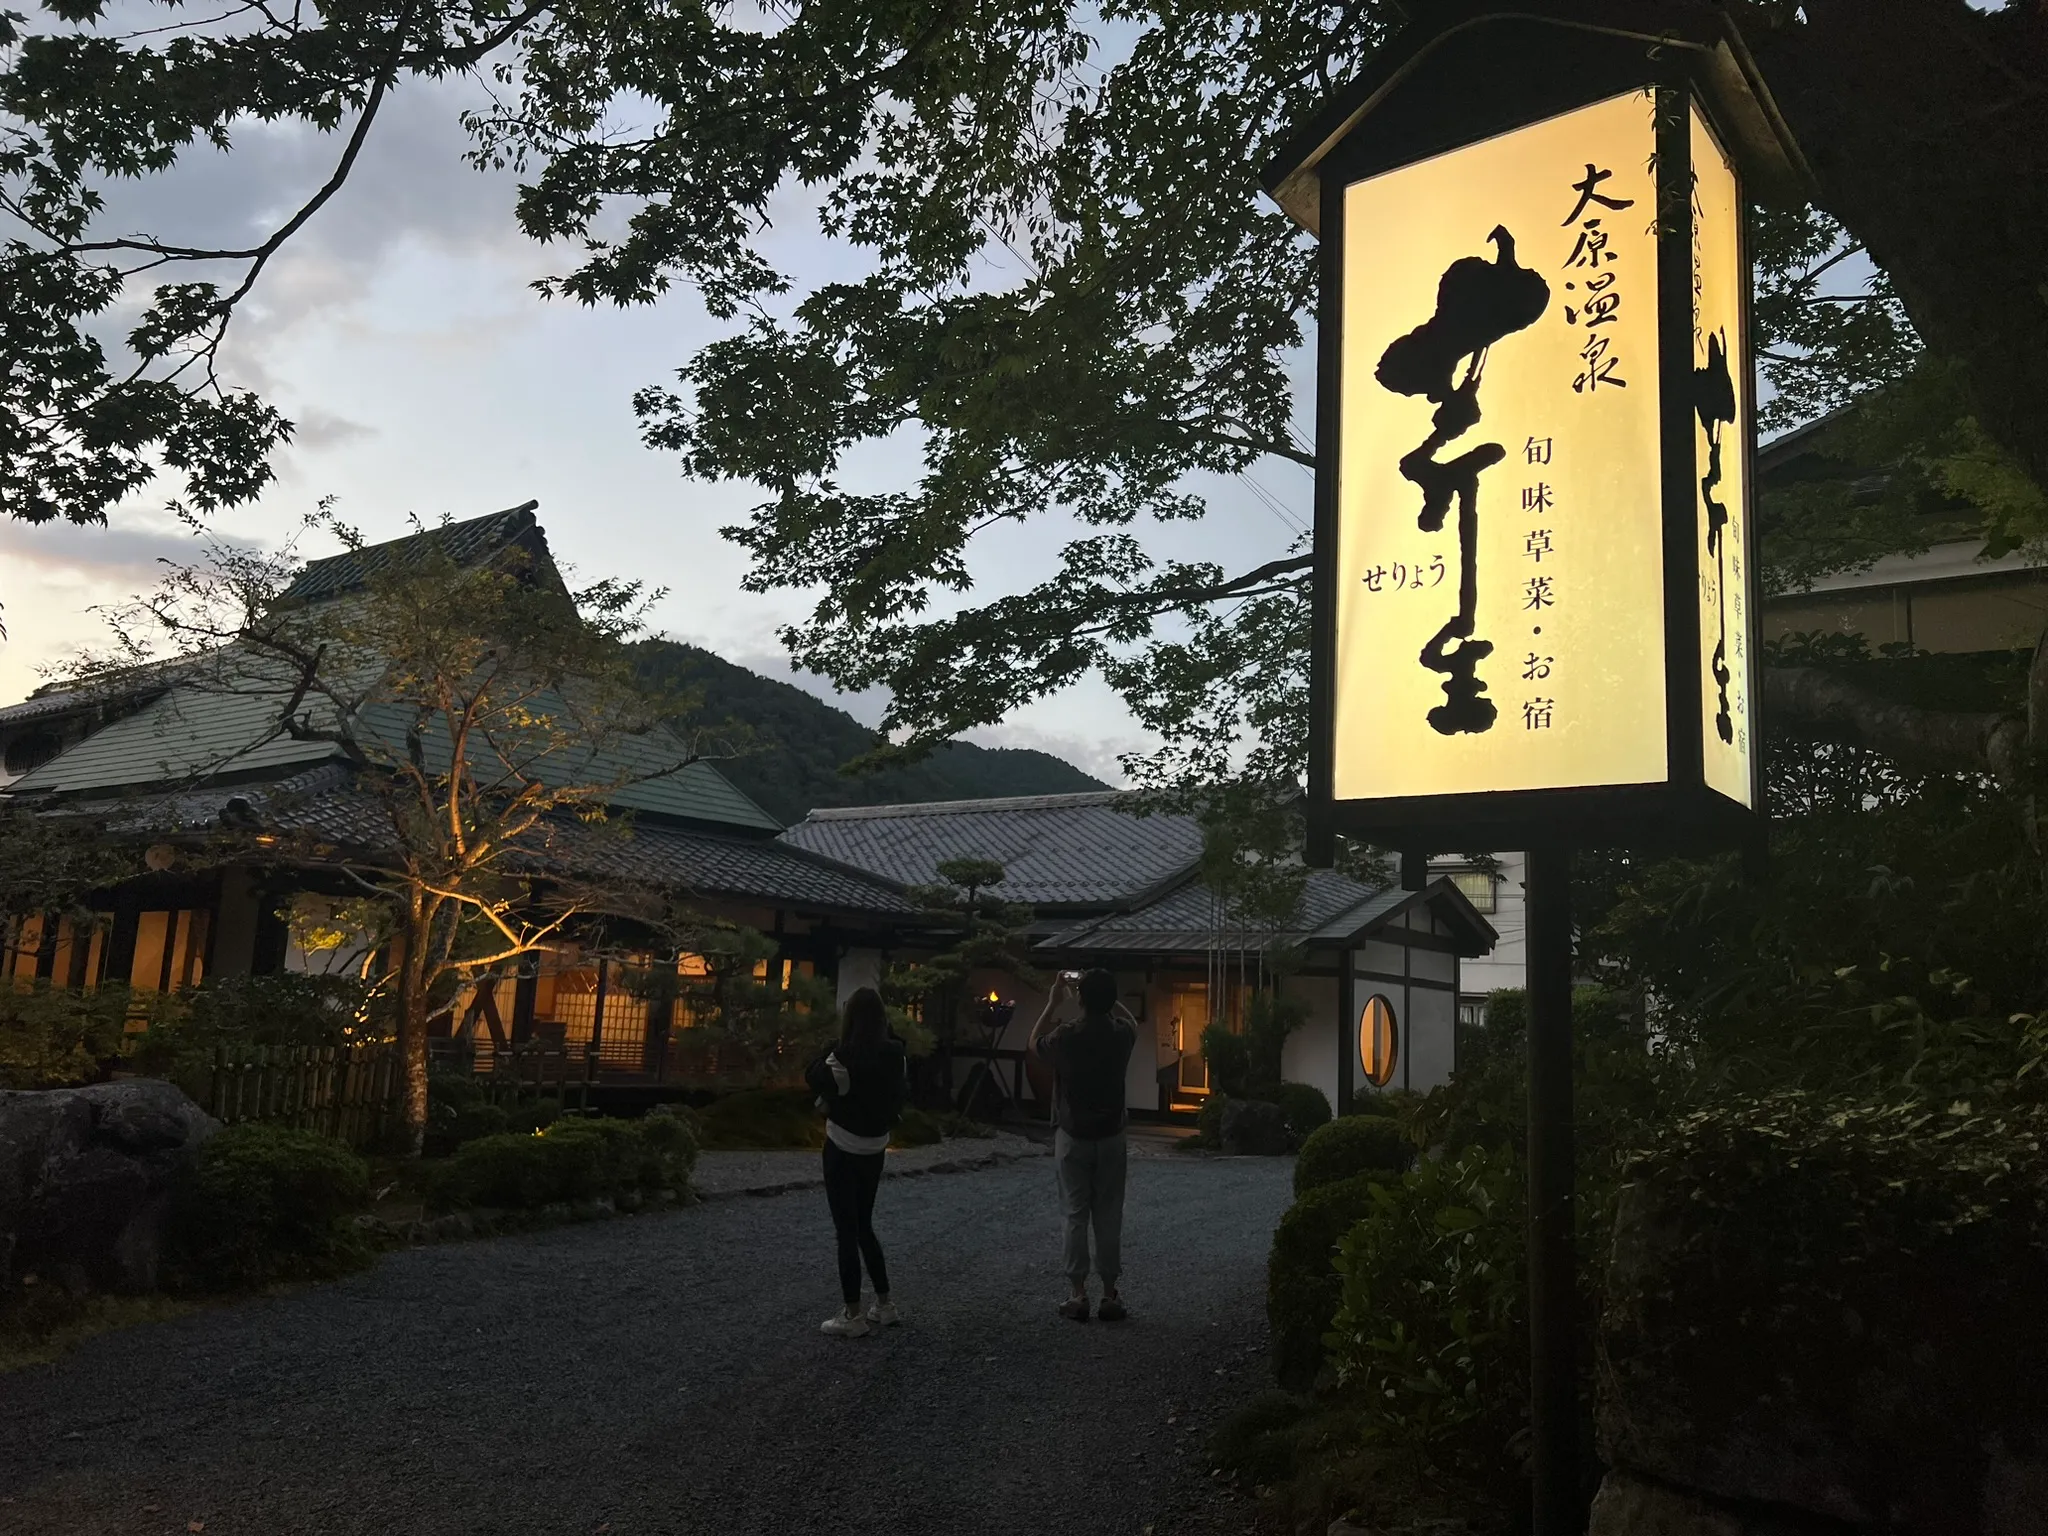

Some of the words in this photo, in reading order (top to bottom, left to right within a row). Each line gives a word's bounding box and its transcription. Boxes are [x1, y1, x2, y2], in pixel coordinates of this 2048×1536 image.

[1561, 163, 1634, 393] 大原温泉
[1362, 553, 1446, 593] せりょう
